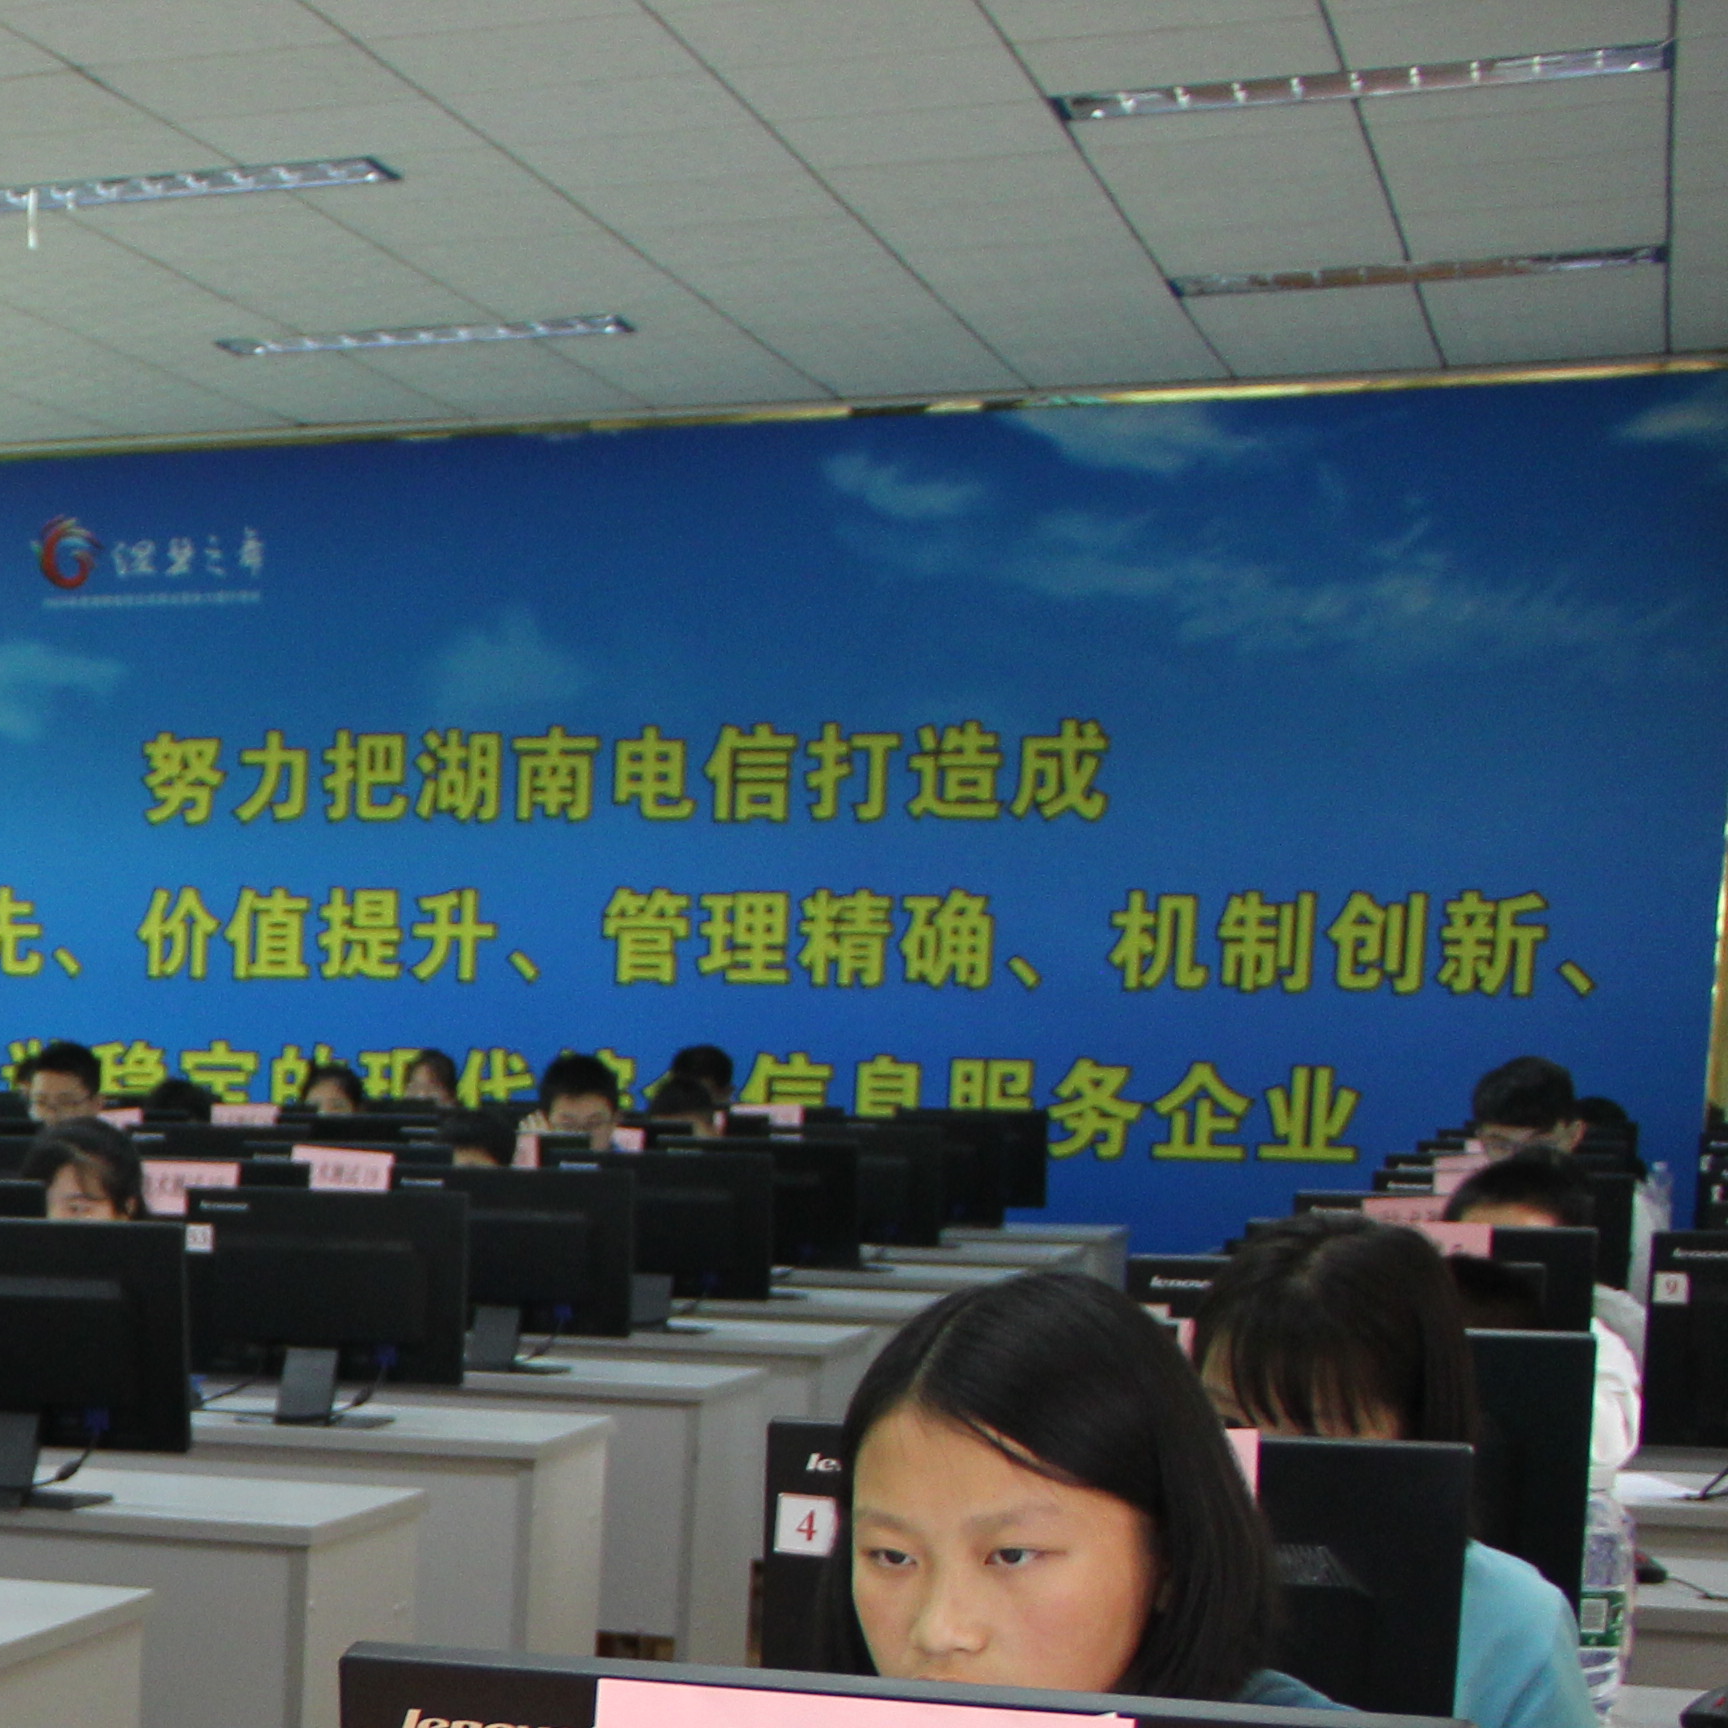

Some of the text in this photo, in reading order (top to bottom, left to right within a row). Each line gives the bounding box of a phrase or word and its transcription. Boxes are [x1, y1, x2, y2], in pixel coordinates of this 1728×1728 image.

[143, 718, 1110, 823] 努力把湖南电信打造成
[796, 1509, 817, 1542] 4
